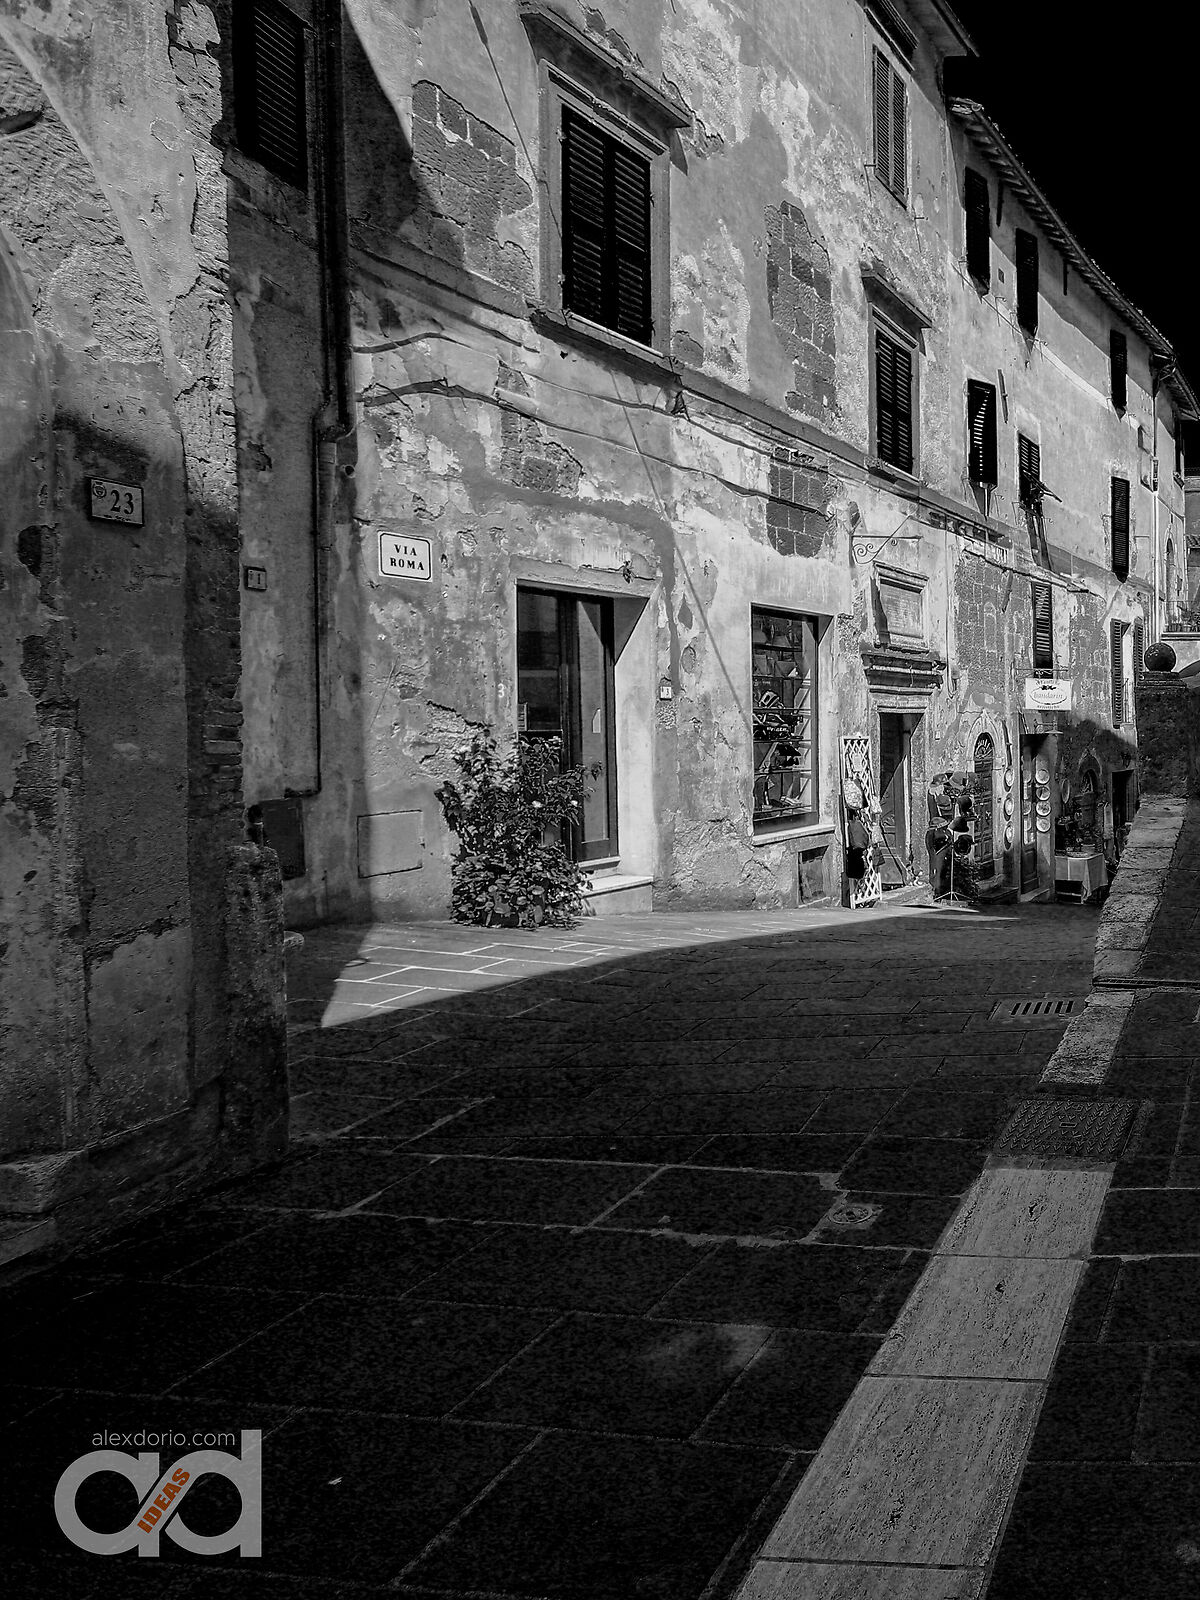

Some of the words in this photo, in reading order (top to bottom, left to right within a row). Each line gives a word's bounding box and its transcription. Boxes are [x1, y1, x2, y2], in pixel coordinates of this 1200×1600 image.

[110, 489, 134, 515] 23
[393, 543, 417, 556] VIA
[390, 557, 425, 571] ROMA
